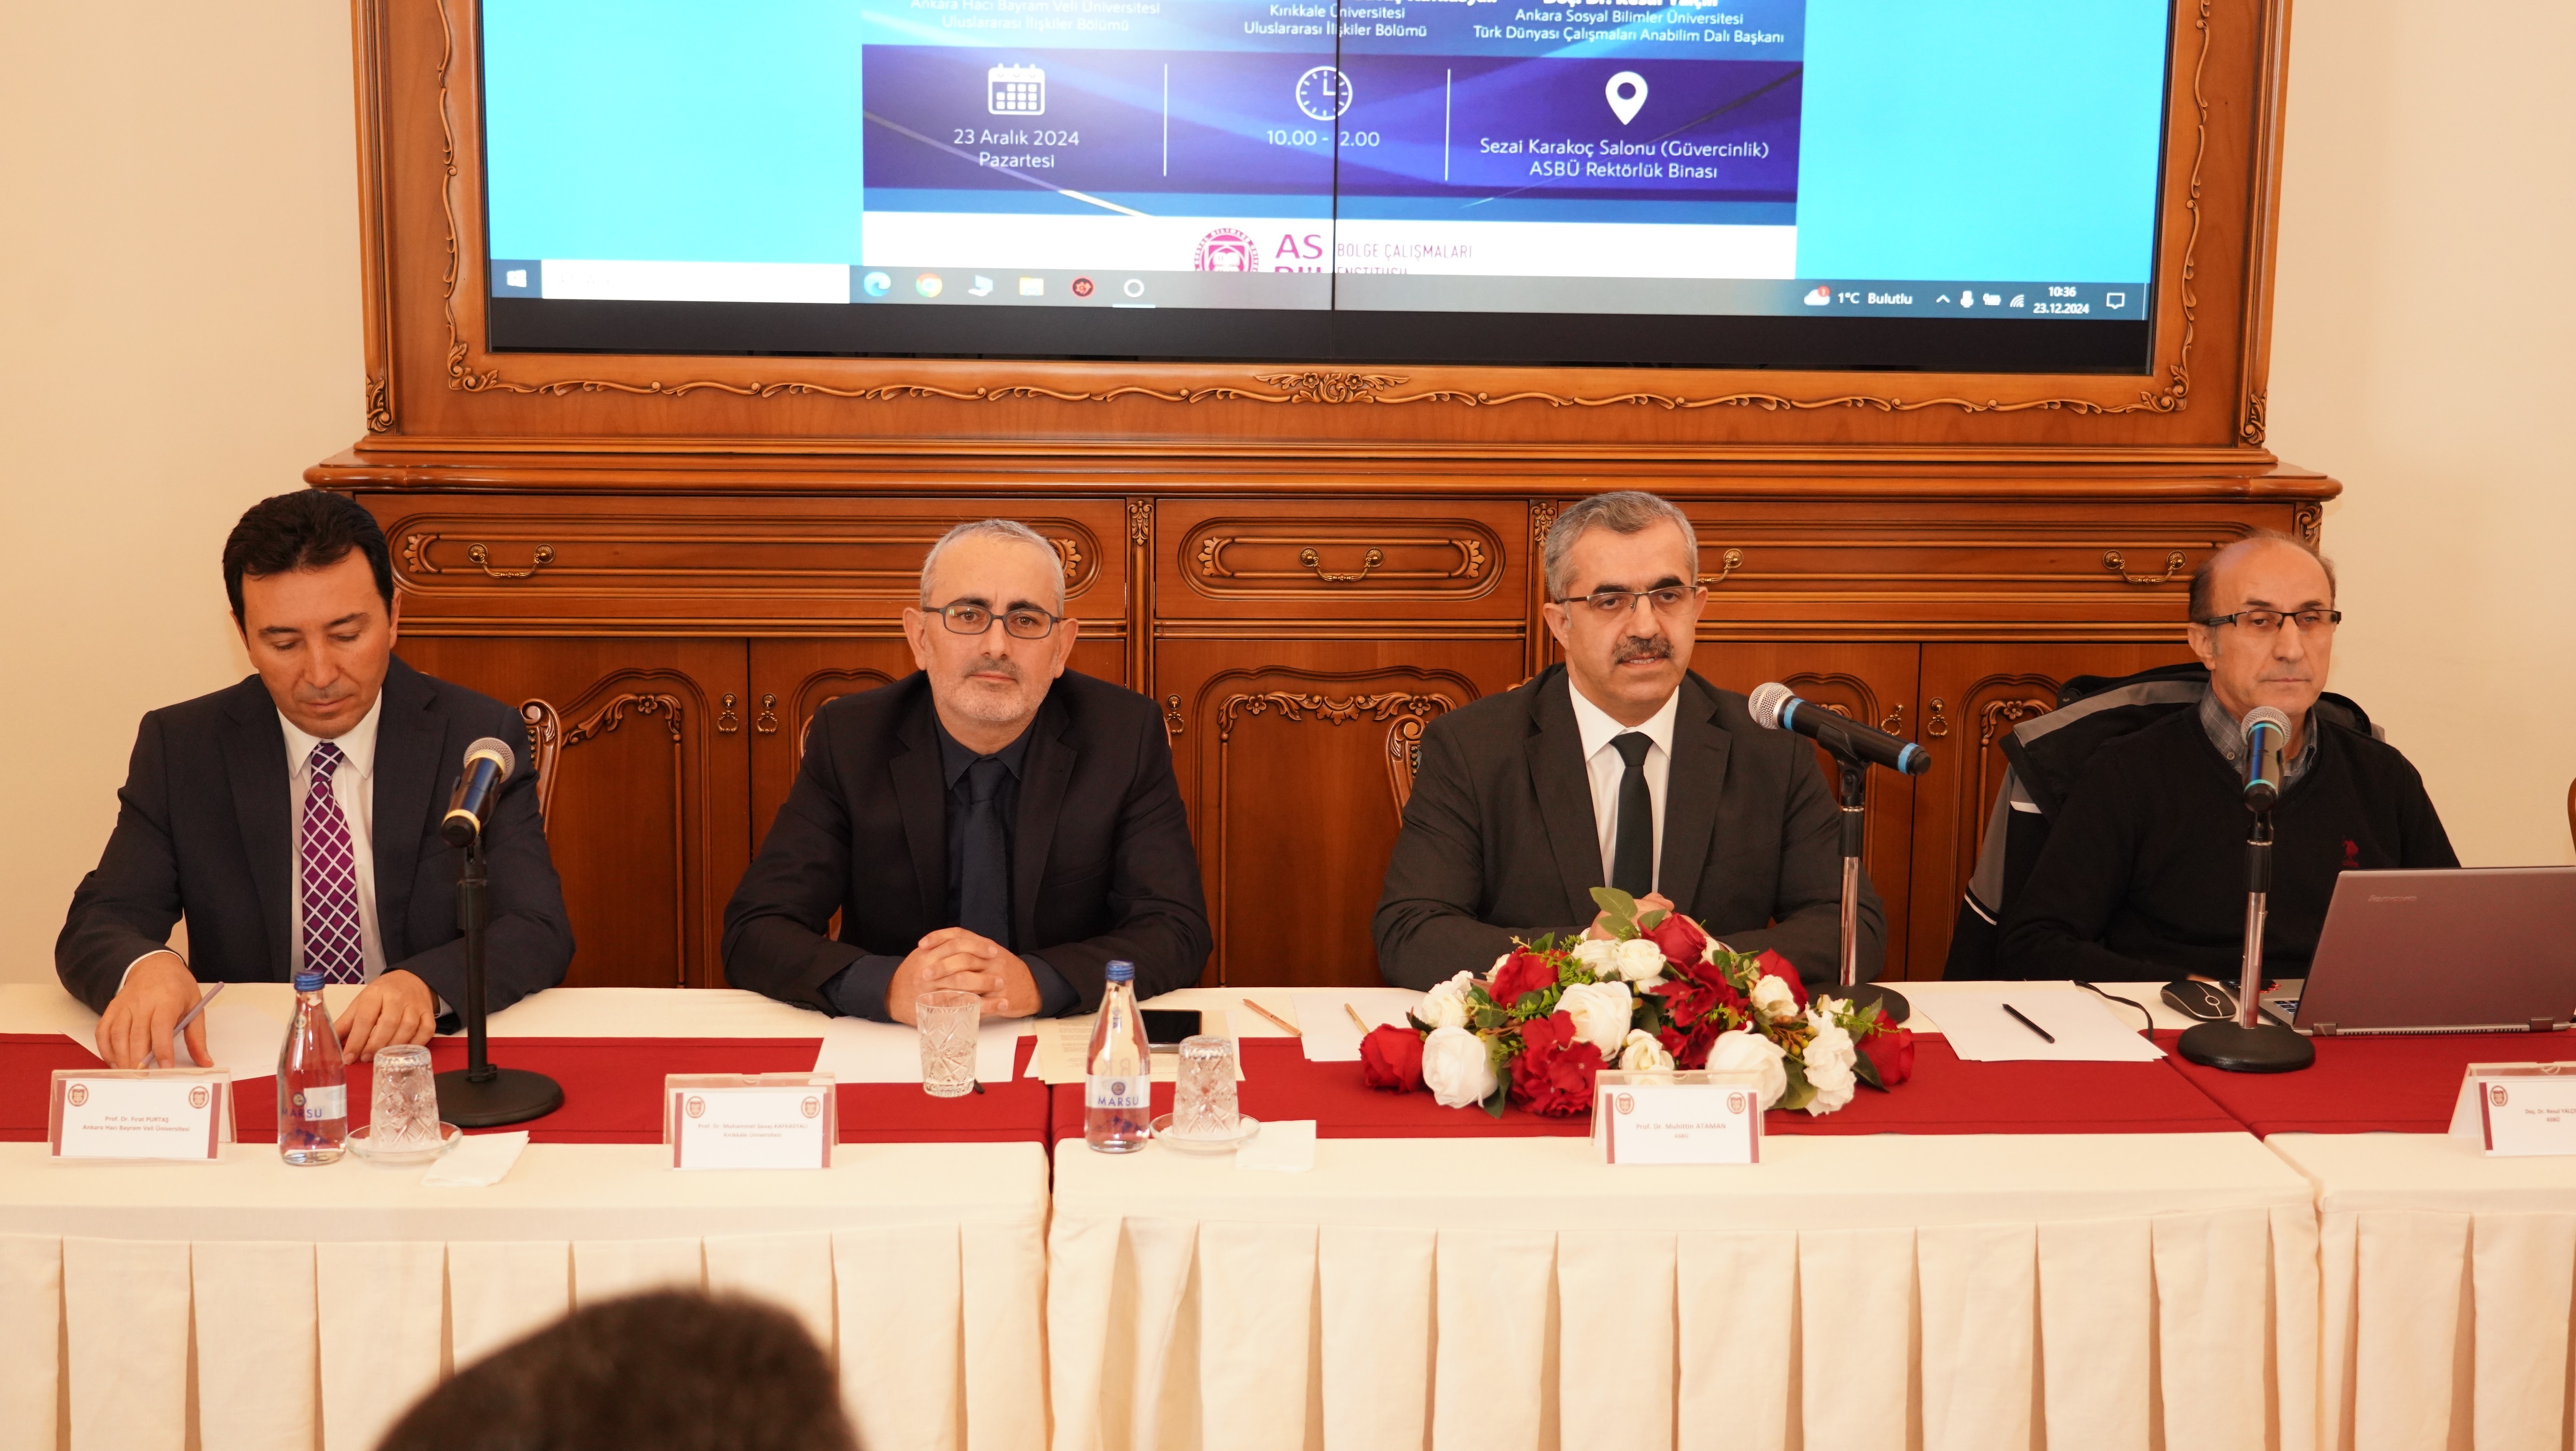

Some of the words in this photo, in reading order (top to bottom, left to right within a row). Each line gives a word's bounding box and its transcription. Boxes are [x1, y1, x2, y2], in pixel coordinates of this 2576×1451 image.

[1270, 4, 1325, 17] Kırıkkale
[1329, 3, 1406, 19] Üniversitesi
[1515, 9, 1562, 22] Ankara
[1566, 9, 1608, 25] Sosyal
[1612, 10, 1663, 24] Bilimler
[1668, 10, 1744, 25] Üniversitesi
[942, 15, 1021, 29] Uluslararası
[1078, 18, 1128, 31] Bölümü
[1244, 21, 1322, 35] Uluslararası
[1376, 23, 1427, 37] Bölümü
[1473, 25, 1501, 39] Türk
[1506, 26, 1559, 42] Dünyası
[1563, 27, 1636, 42] Çalışmaları
[1640, 28, 1700, 42] Anabilim
[1705, 29, 1730, 42] Dalı
[1735, 30, 1784, 44] Başkanı
[954, 129, 975, 144] 23
[980, 129, 1029, 145] Aralık
[1033, 130, 1080, 146] 2024
[1267, 130, 1317, 146] 10.00
[1480, 138, 1523, 154] Sezai
[1529, 140, 1595, 158] Karakoç
[1599, 140, 1656, 156] Salonu
[1660, 141, 1769, 158] (Güvercinlik)
[979, 151, 1055, 168] Pazartesi
[1529, 159, 1579, 177] ASBÜ
[1587, 163, 1663, 178] Rektörlük
[1668, 164, 1718, 179] Binası
[1275, 234, 1323, 259] AS
[1338, 240, 1380, 257] BÖLGE
[1385, 243, 1472, 260] ÇALIŞMALARI
[1838, 292, 1860, 304] 1°C
[1868, 292, 1913, 304] Bulutlu
[2048, 286, 2077, 297] 10:36
[2033, 303, 2090, 314] 23.12.2024
[1098, 1096, 1139, 1106] MARSU
